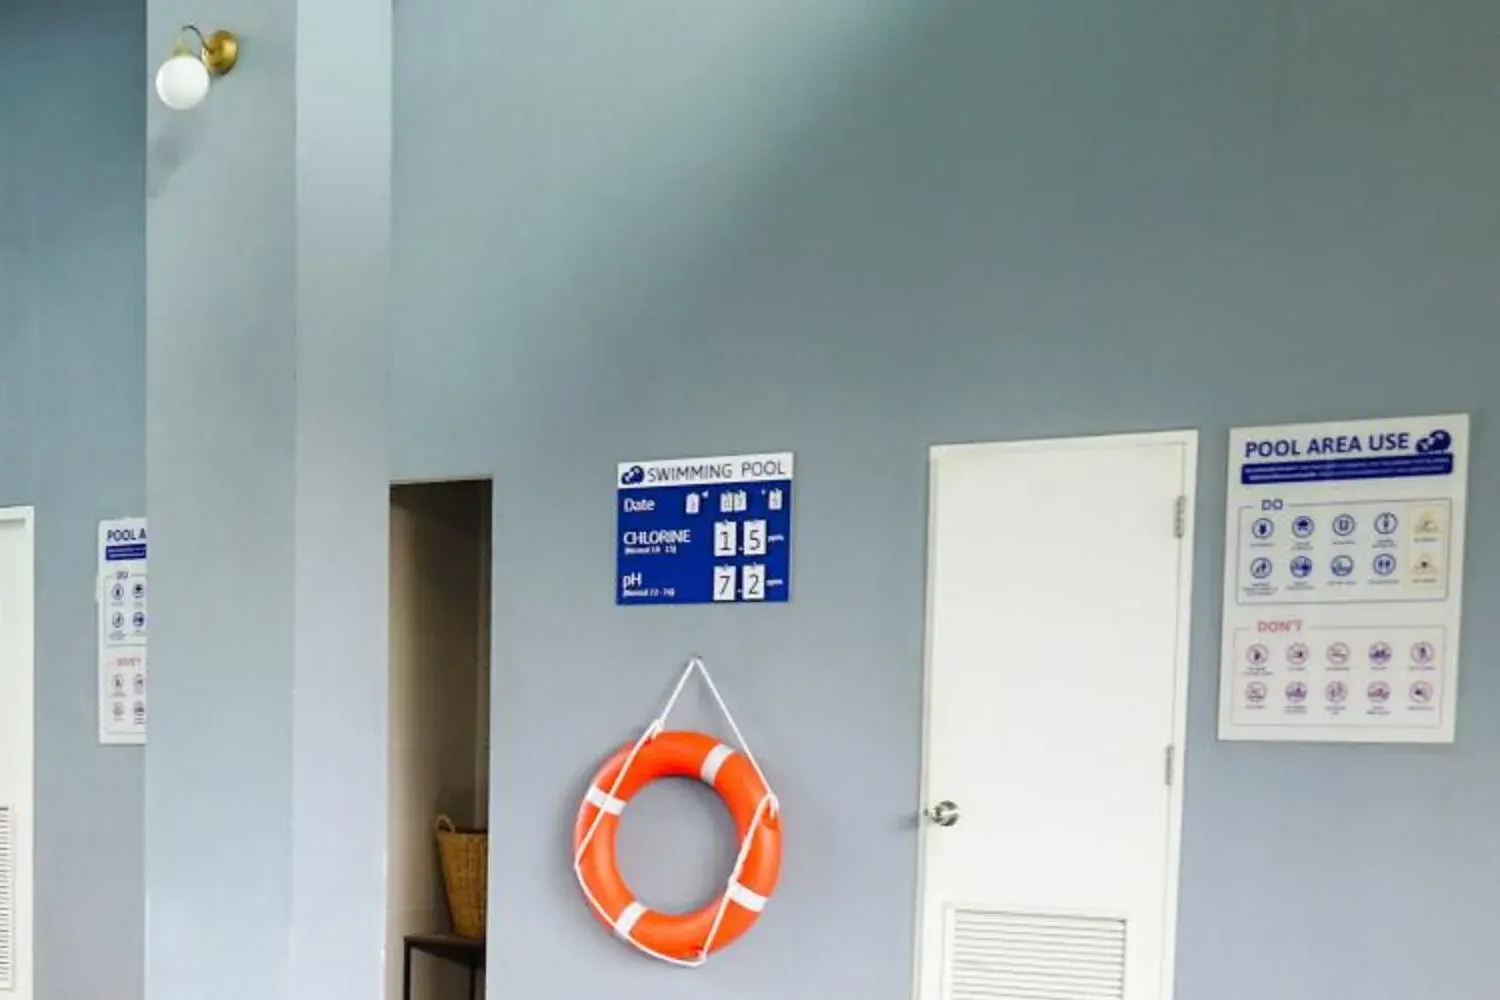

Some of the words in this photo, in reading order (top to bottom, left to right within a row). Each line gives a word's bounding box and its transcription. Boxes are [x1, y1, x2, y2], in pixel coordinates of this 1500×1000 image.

[1245, 439, 1301, 457] POOL
[1306, 435, 1362, 454] AREA
[1369, 432, 1409, 450] USE
[646, 463, 733, 482] SWIMMING
[741, 460, 785, 476] POOL
[623, 498, 655, 512] Date
[1261, 498, 1283, 511] DO
[107, 529, 136, 542] POOL
[623, 530, 691, 545] CHLORINE
[623, 572, 642, 590] pH
